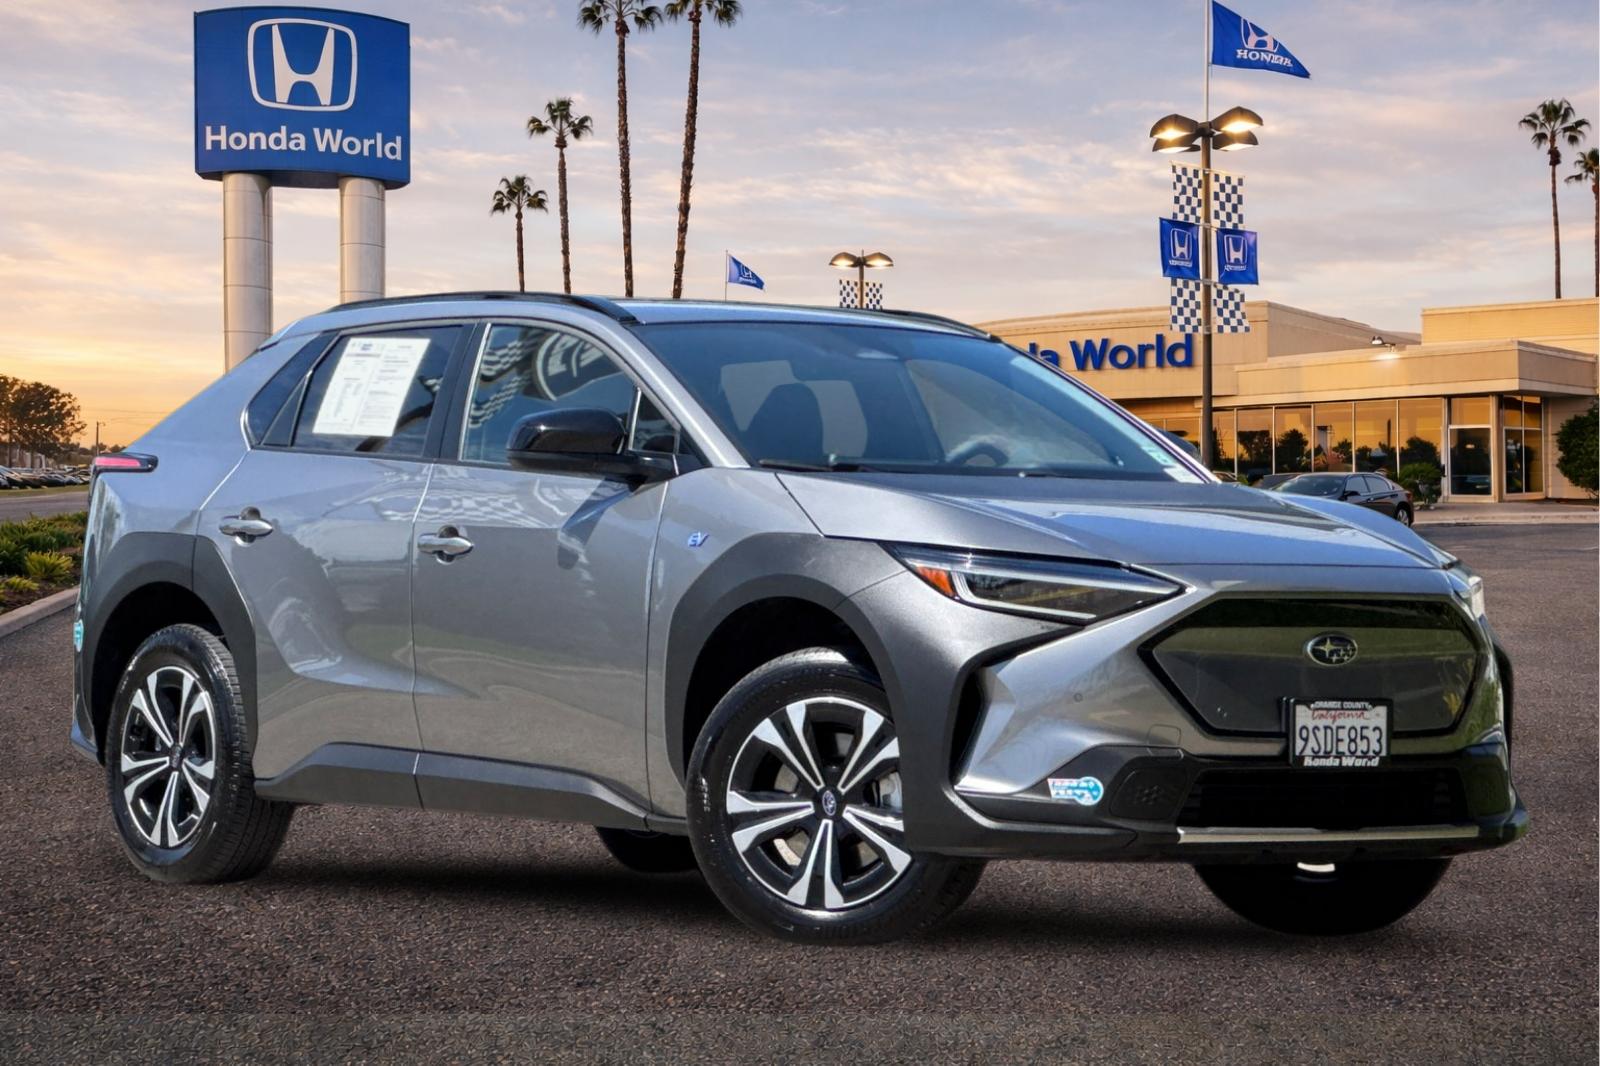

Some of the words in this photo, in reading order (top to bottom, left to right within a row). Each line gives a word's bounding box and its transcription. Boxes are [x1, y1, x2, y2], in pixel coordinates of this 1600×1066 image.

[205, 125, 306, 151] Honda
[313, 127, 402, 161] World
[1069, 333, 1194, 371] World
[1312, 709, 1369, 724] California
[1343, 701, 1370, 709] COUNTY
[1299, 725, 1383, 756] 9SDE853
[1304, 756, 1340, 766] Honda
[1341, 756, 1380, 766] World
